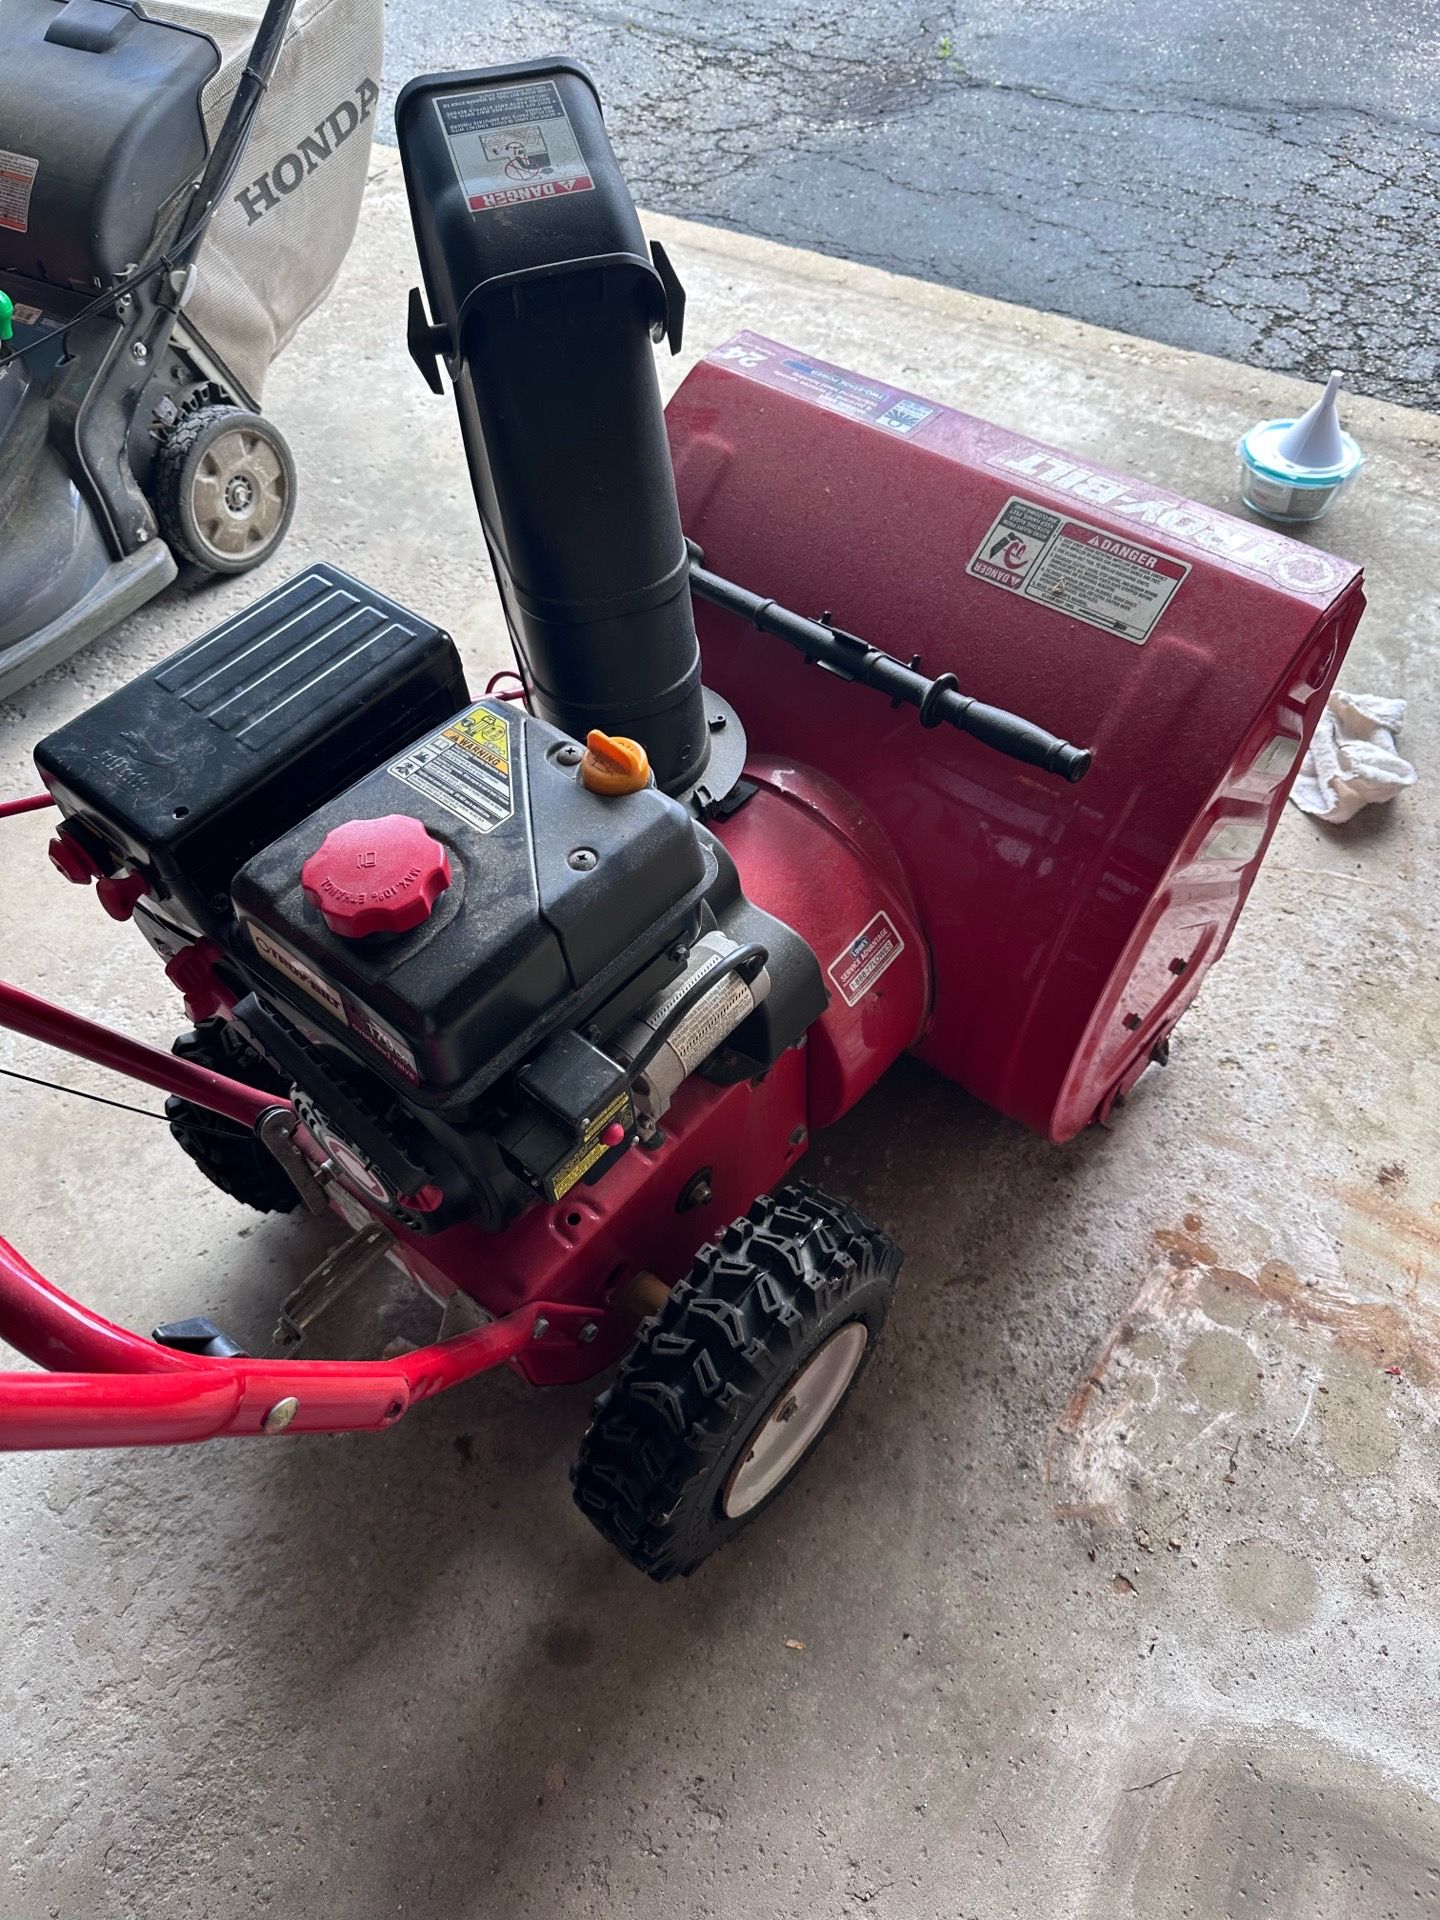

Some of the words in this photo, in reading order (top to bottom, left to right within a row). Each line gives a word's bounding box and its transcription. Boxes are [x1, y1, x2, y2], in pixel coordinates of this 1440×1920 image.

[234, 77, 380, 226] HONDA
[483, 184, 556, 207] DANGER
[1006, 452, 1271, 561] TROY-BILT
[973, 562, 1010, 582] DANGER
[1101, 539, 1158, 568] DANGER
[459, 738, 501, 766] WARNING
[840, 956, 862, 982] SERVICE
[860, 927, 889, 959] ADVANTAGE
[851, 942, 892, 989] 1-888-77LOWES
[269, 946, 341, 1011] TROY-BILT
[392, 1056, 415, 1081] valve
